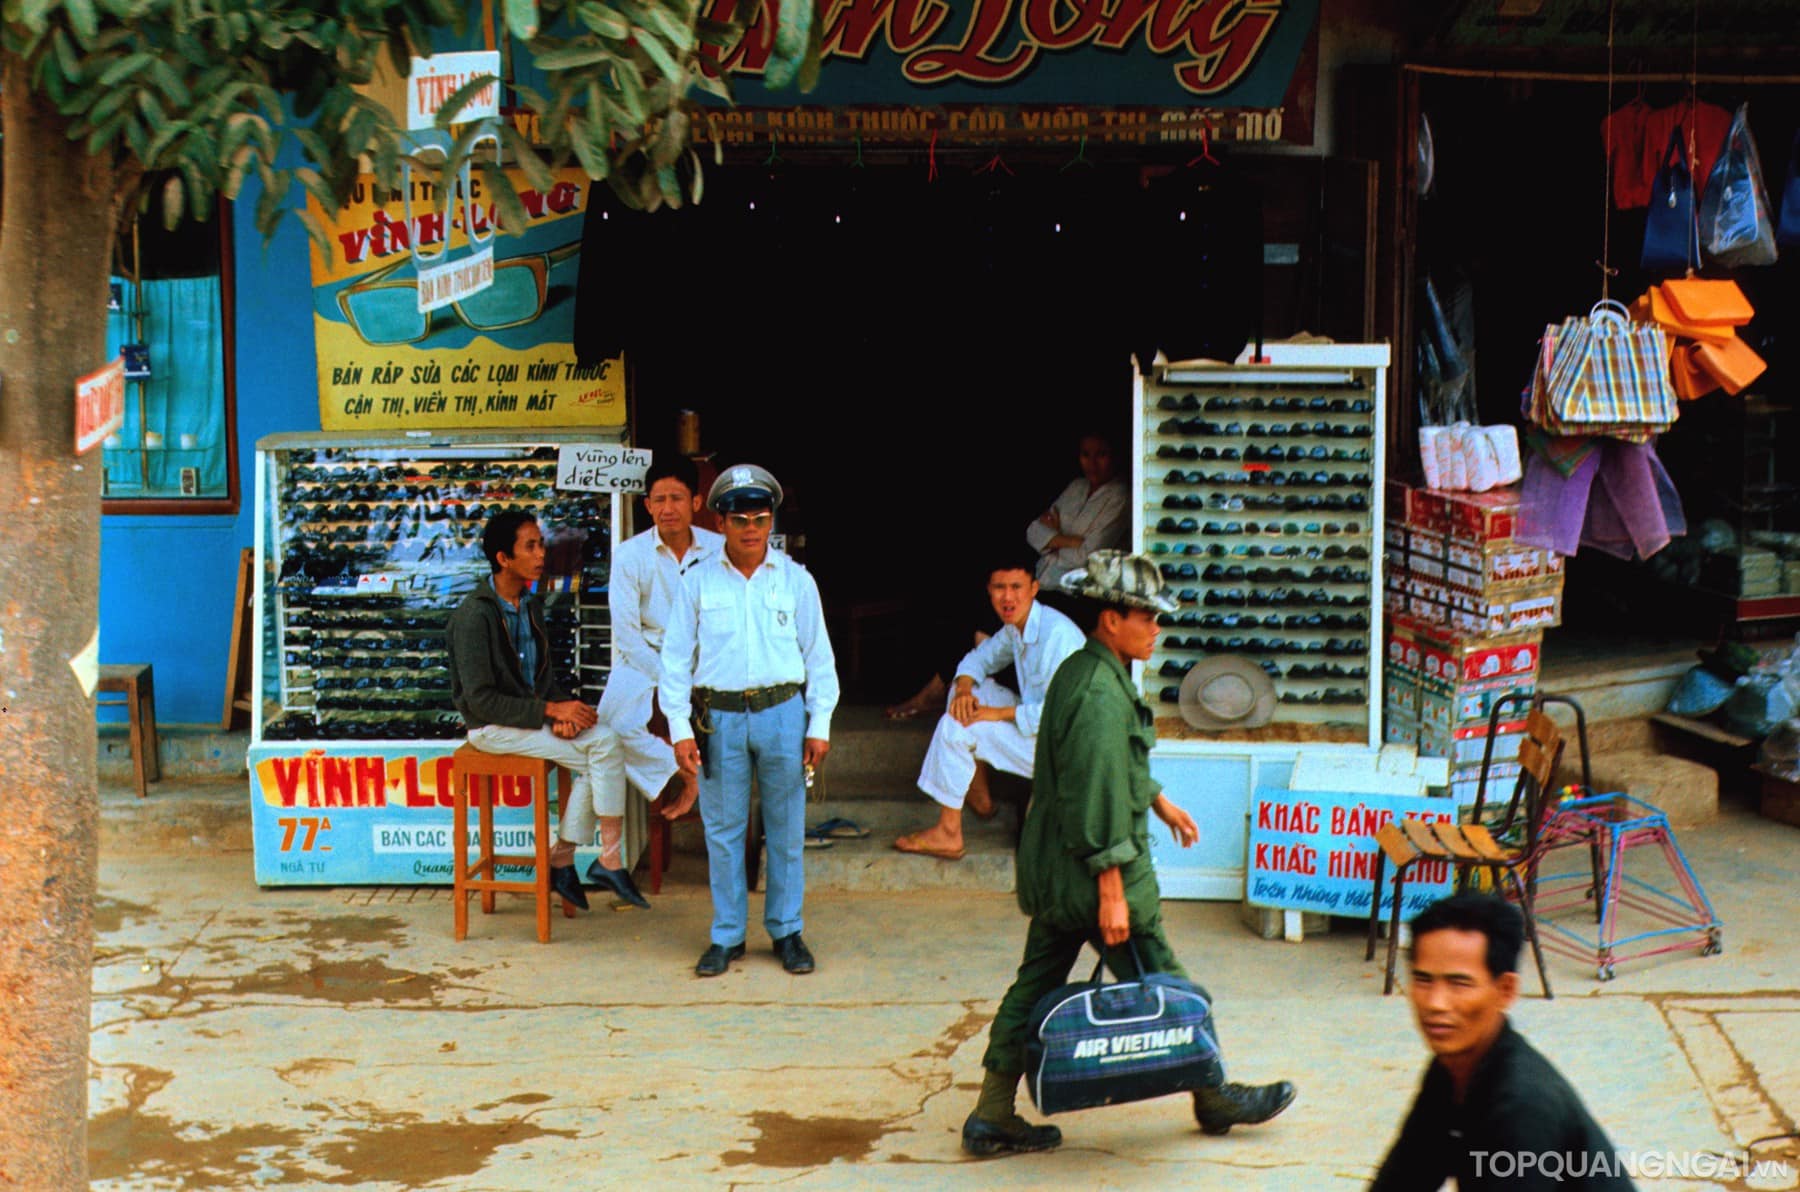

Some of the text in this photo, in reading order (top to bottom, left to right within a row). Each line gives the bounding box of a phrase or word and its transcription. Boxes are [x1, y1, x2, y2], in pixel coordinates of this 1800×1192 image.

[451, 358, 480, 384] CÁC
[526, 358, 559, 382] KÍNH
[486, 390, 519, 412] KÍNH
[526, 389, 558, 411] MÁT
[1073, 1025, 1195, 1059] AIR VIETNAM
